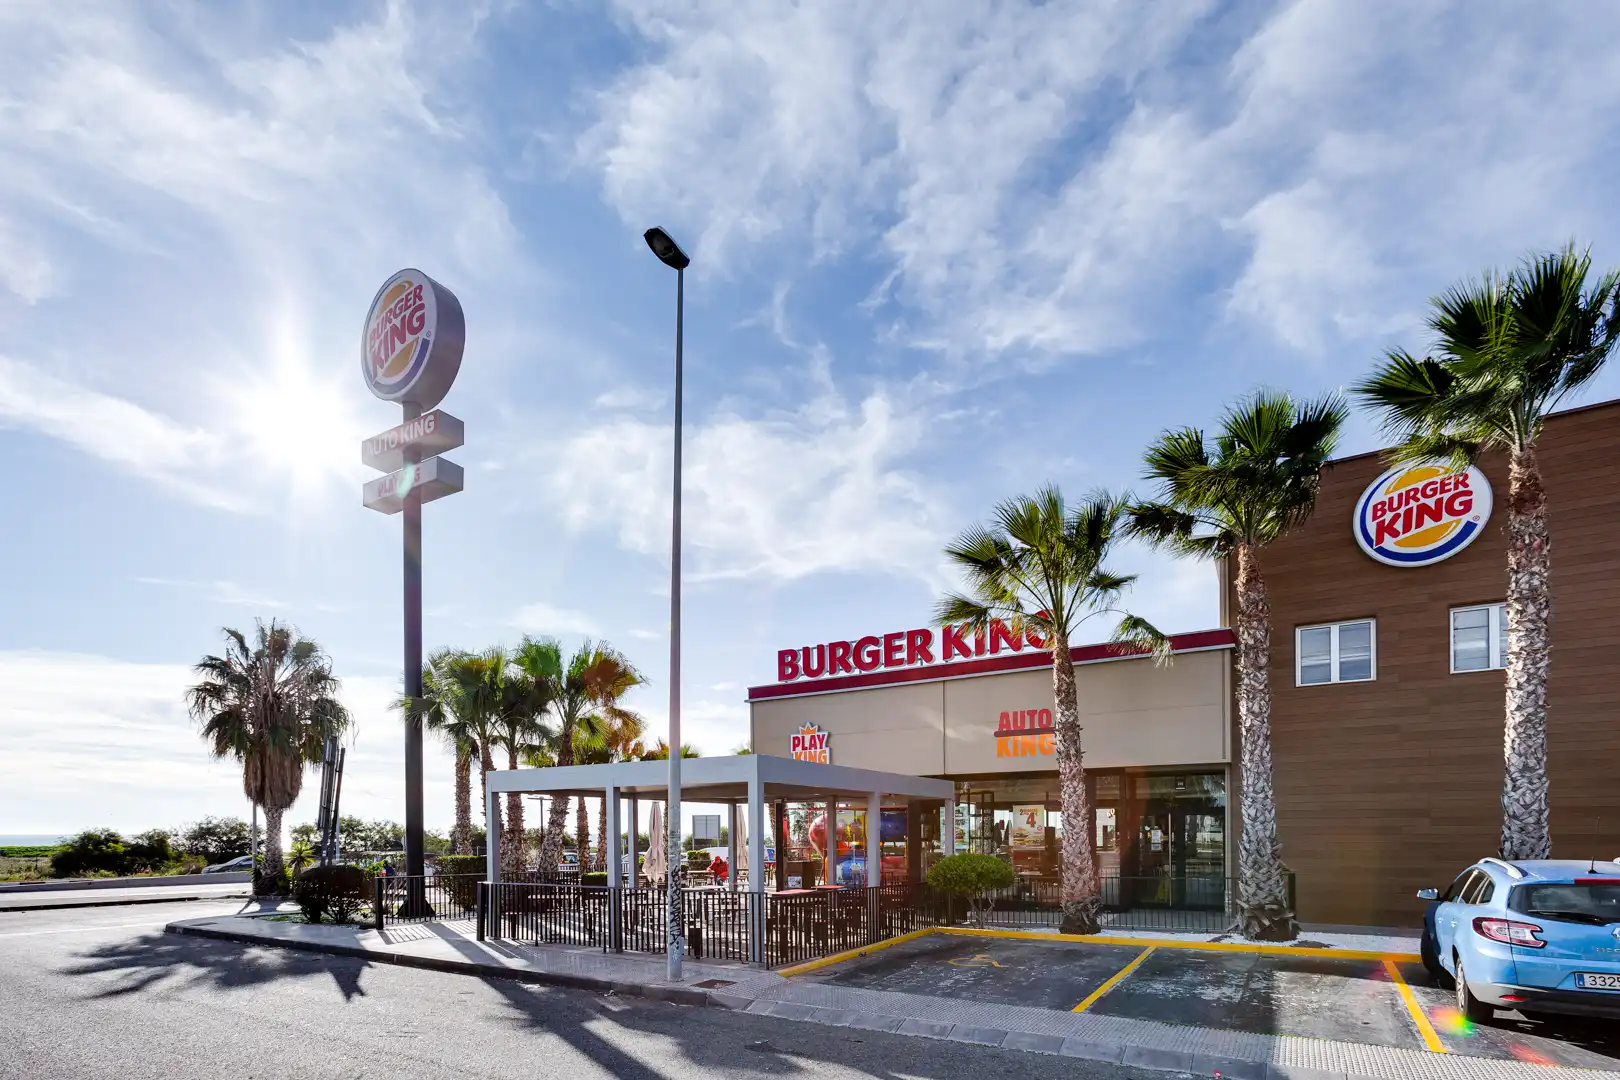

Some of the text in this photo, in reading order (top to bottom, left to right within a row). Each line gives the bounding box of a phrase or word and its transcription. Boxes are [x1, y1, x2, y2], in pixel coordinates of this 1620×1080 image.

[369, 284, 423, 352] BURGER
[372, 303, 425, 380] KING
[366, 414, 434, 456] AUTO KING
[1372, 473, 1469, 522] BURGER
[1374, 490, 1473, 547] KING
[777, 628, 935, 682] BURGER
[792, 733, 826, 751] PLAY
[998, 709, 1052, 732] AUTO
[997, 734, 1055, 758] KING
